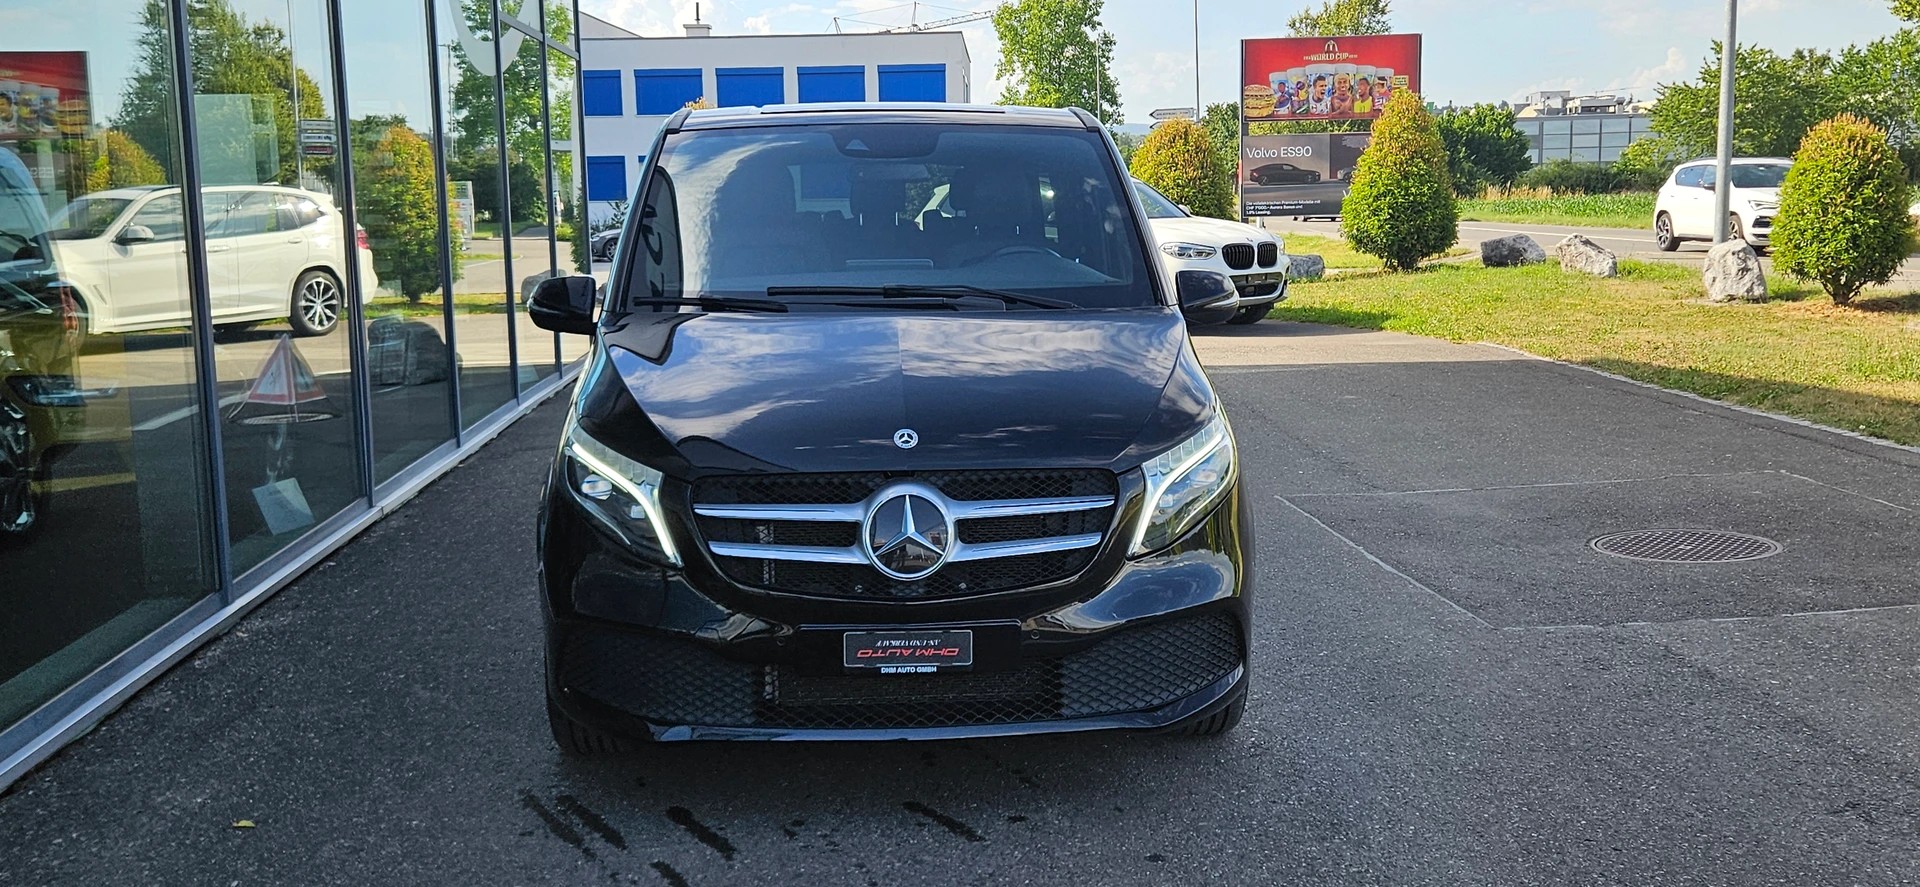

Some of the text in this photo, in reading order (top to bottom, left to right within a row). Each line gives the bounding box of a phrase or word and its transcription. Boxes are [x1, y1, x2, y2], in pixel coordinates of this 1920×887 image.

[1246, 146, 1312, 158] Volvo ES90
[856, 648, 914, 658] AUTO
